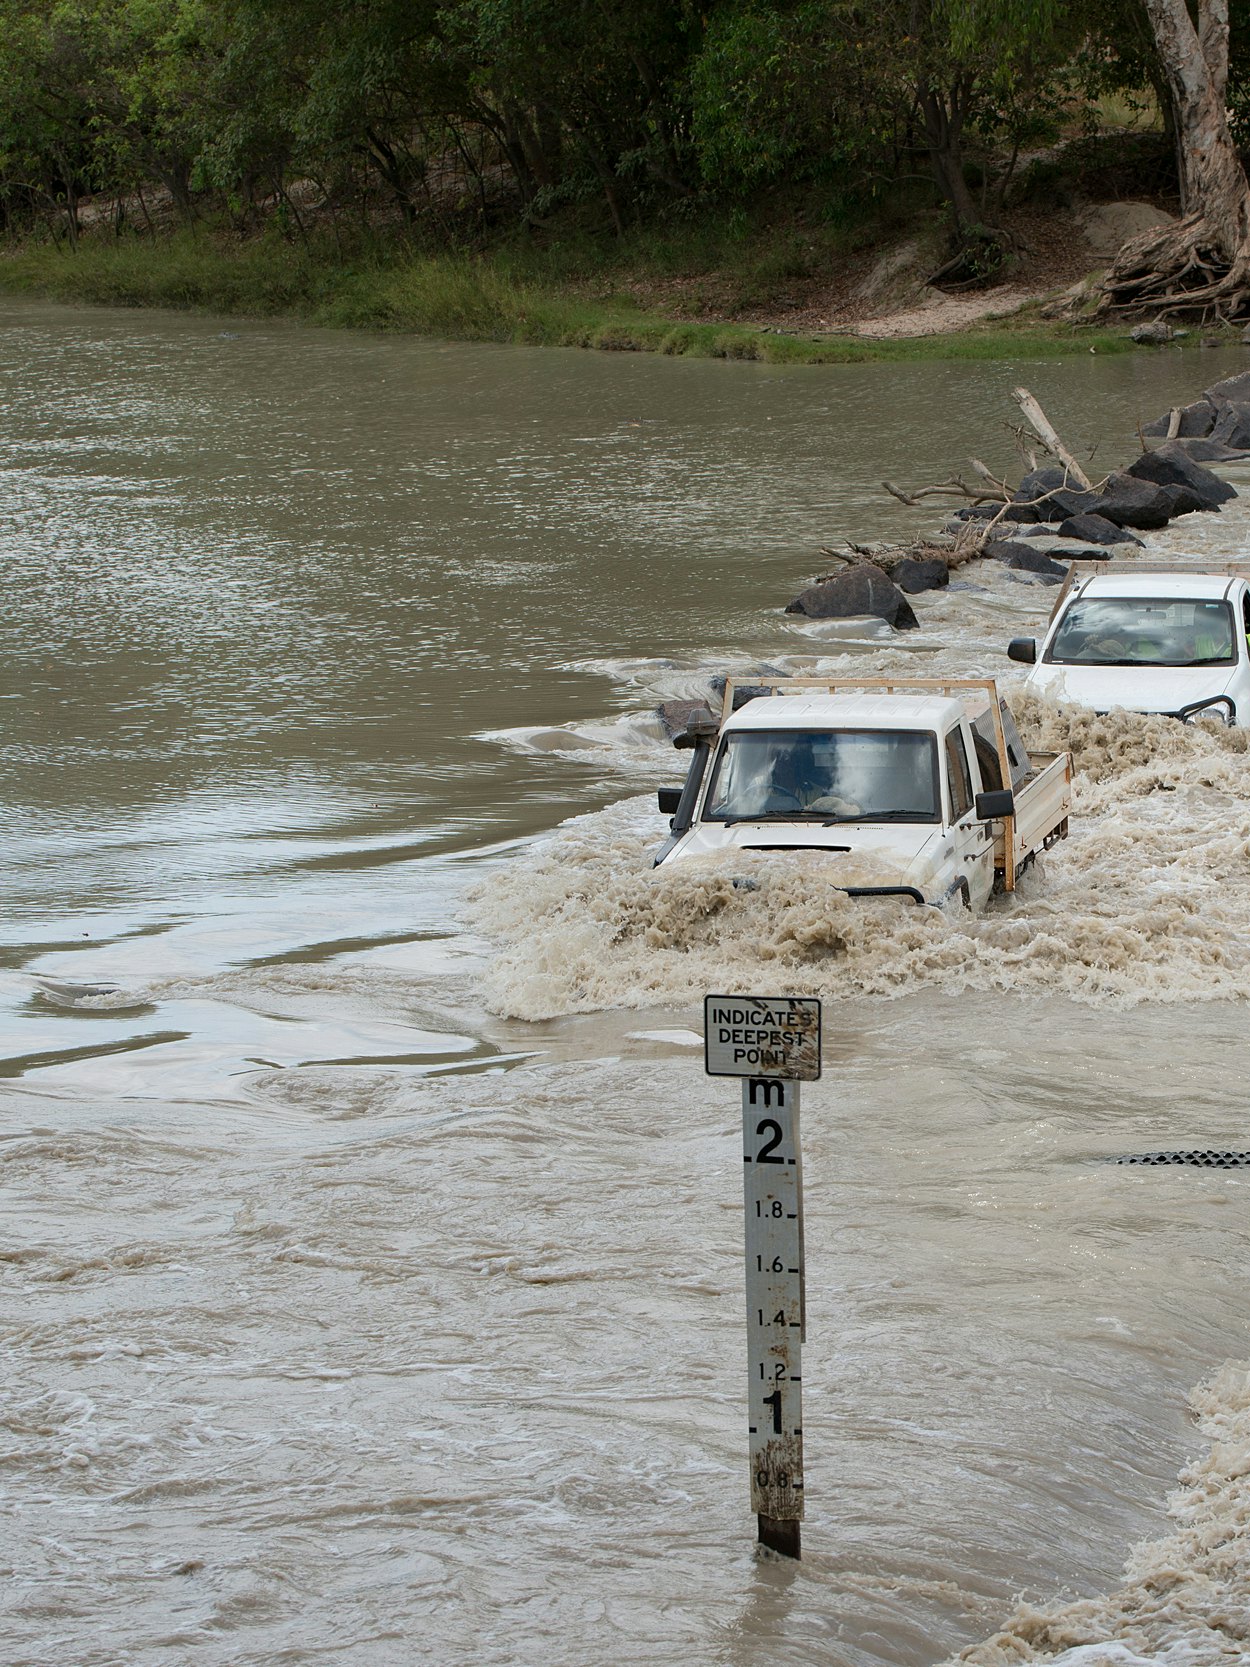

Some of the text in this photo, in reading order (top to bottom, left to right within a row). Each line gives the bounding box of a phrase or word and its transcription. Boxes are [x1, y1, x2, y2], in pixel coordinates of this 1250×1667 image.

[713, 1009, 814, 1028] INDICATES
[719, 1028, 806, 1047] DEEPEST
[733, 1048, 789, 1065] POINT
[748, 1078, 785, 1107] m
[756, 1118, 785, 1165] 2
[755, 1200, 783, 1219] 1.8
[756, 1254, 784, 1273] 1.6
[757, 1309, 785, 1327] 1.4
[759, 1362, 786, 1381] 1.2
[762, 1390, 783, 1435] 1
[756, 1471, 789, 1489] 0.8
